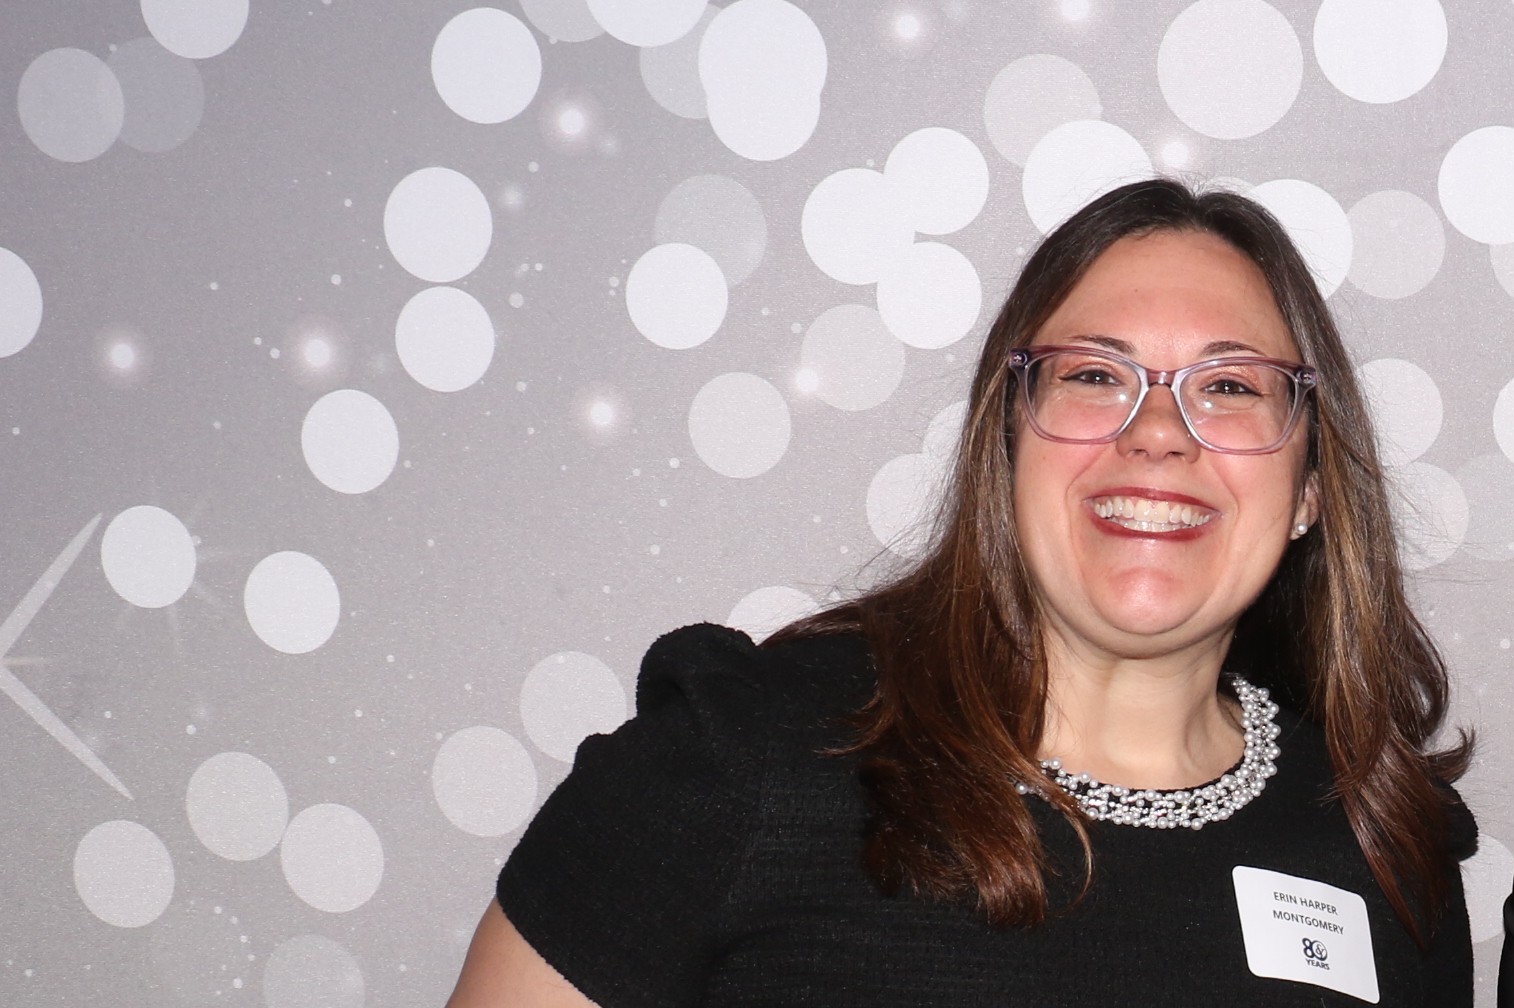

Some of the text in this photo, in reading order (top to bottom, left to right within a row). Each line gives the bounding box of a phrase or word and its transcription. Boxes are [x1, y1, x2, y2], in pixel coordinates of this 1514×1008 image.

[1273, 891, 1338, 915] ERIN HARPER
[1273, 910, 1345, 935] MONTGOMERY
[1305, 959, 1330, 970] YEARS
